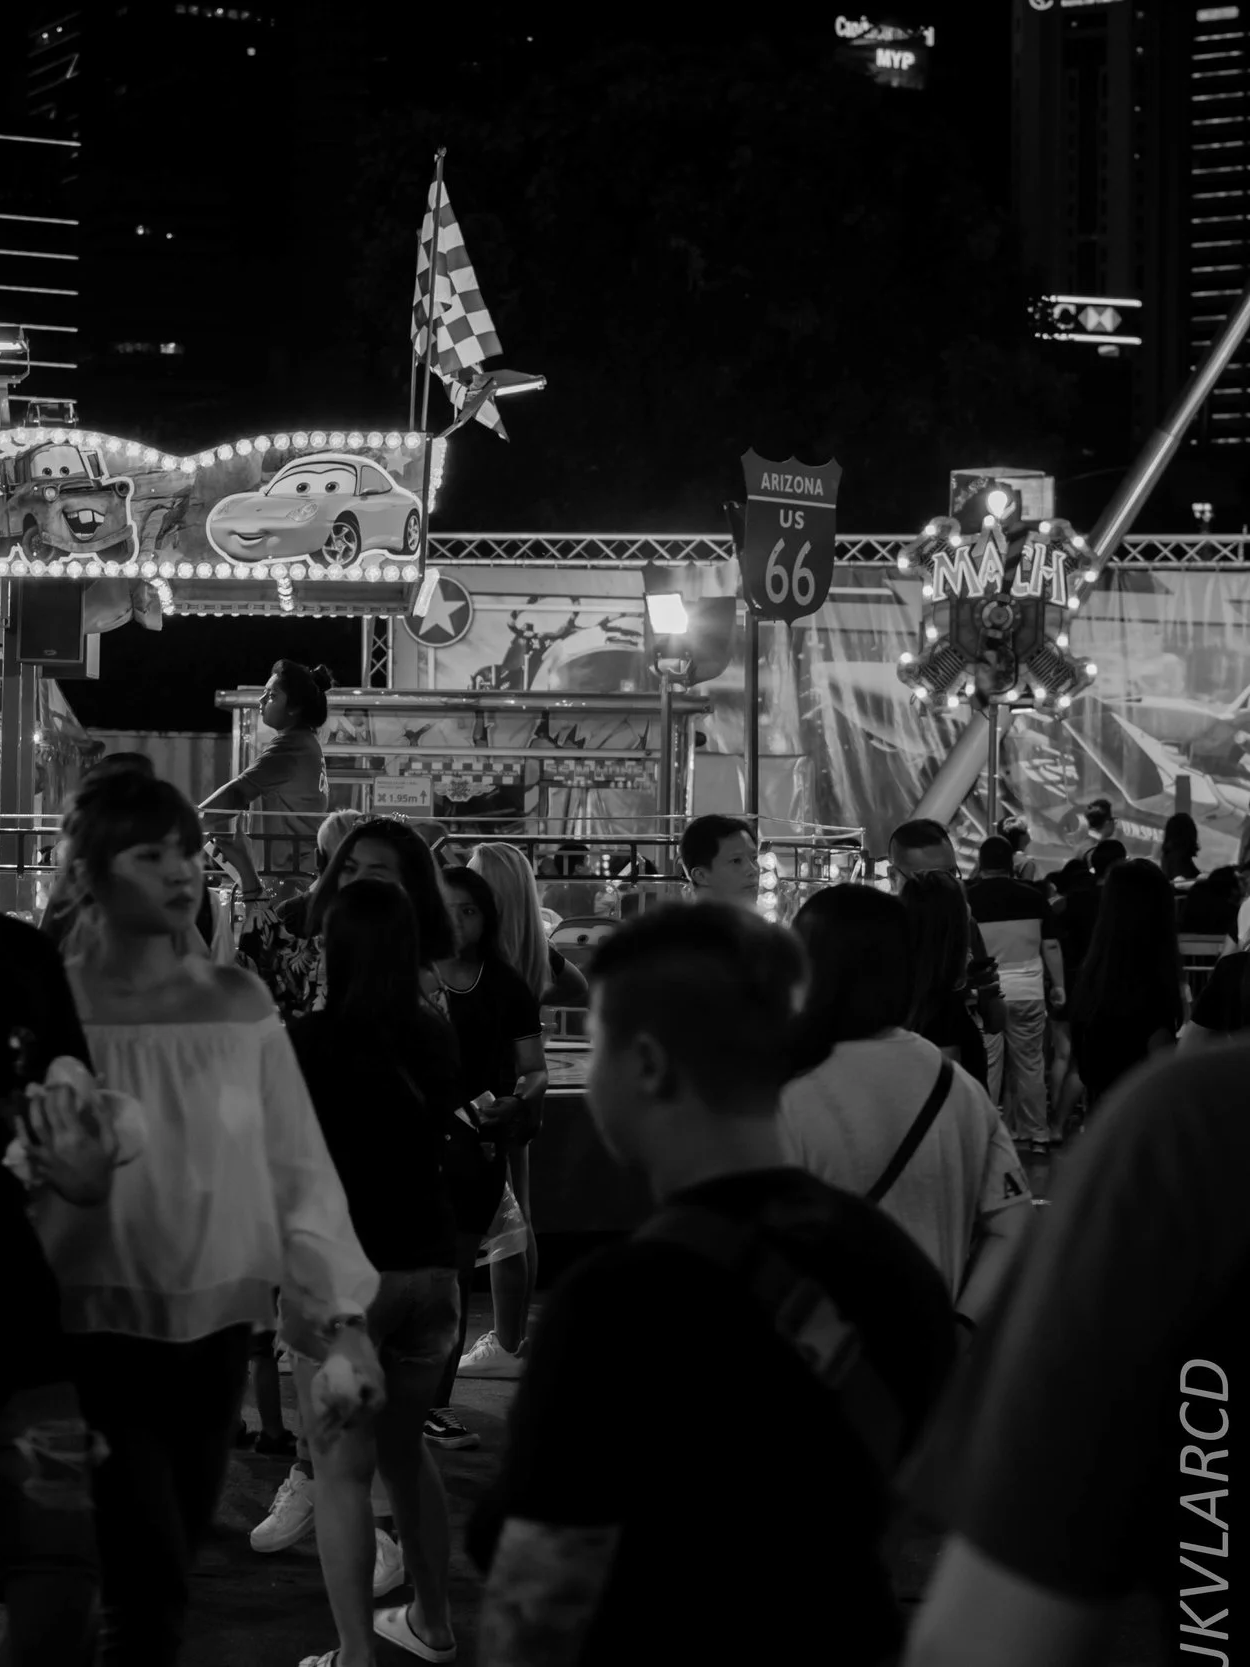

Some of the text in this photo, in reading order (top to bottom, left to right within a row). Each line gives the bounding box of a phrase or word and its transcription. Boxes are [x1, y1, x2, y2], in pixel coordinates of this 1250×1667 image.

[876, 48, 916, 70] MYP
[760, 472, 824, 496] ARIZONA
[779, 509, 805, 530] US
[765, 537, 816, 606] 66
[1004, 1172, 1022, 1199] A
